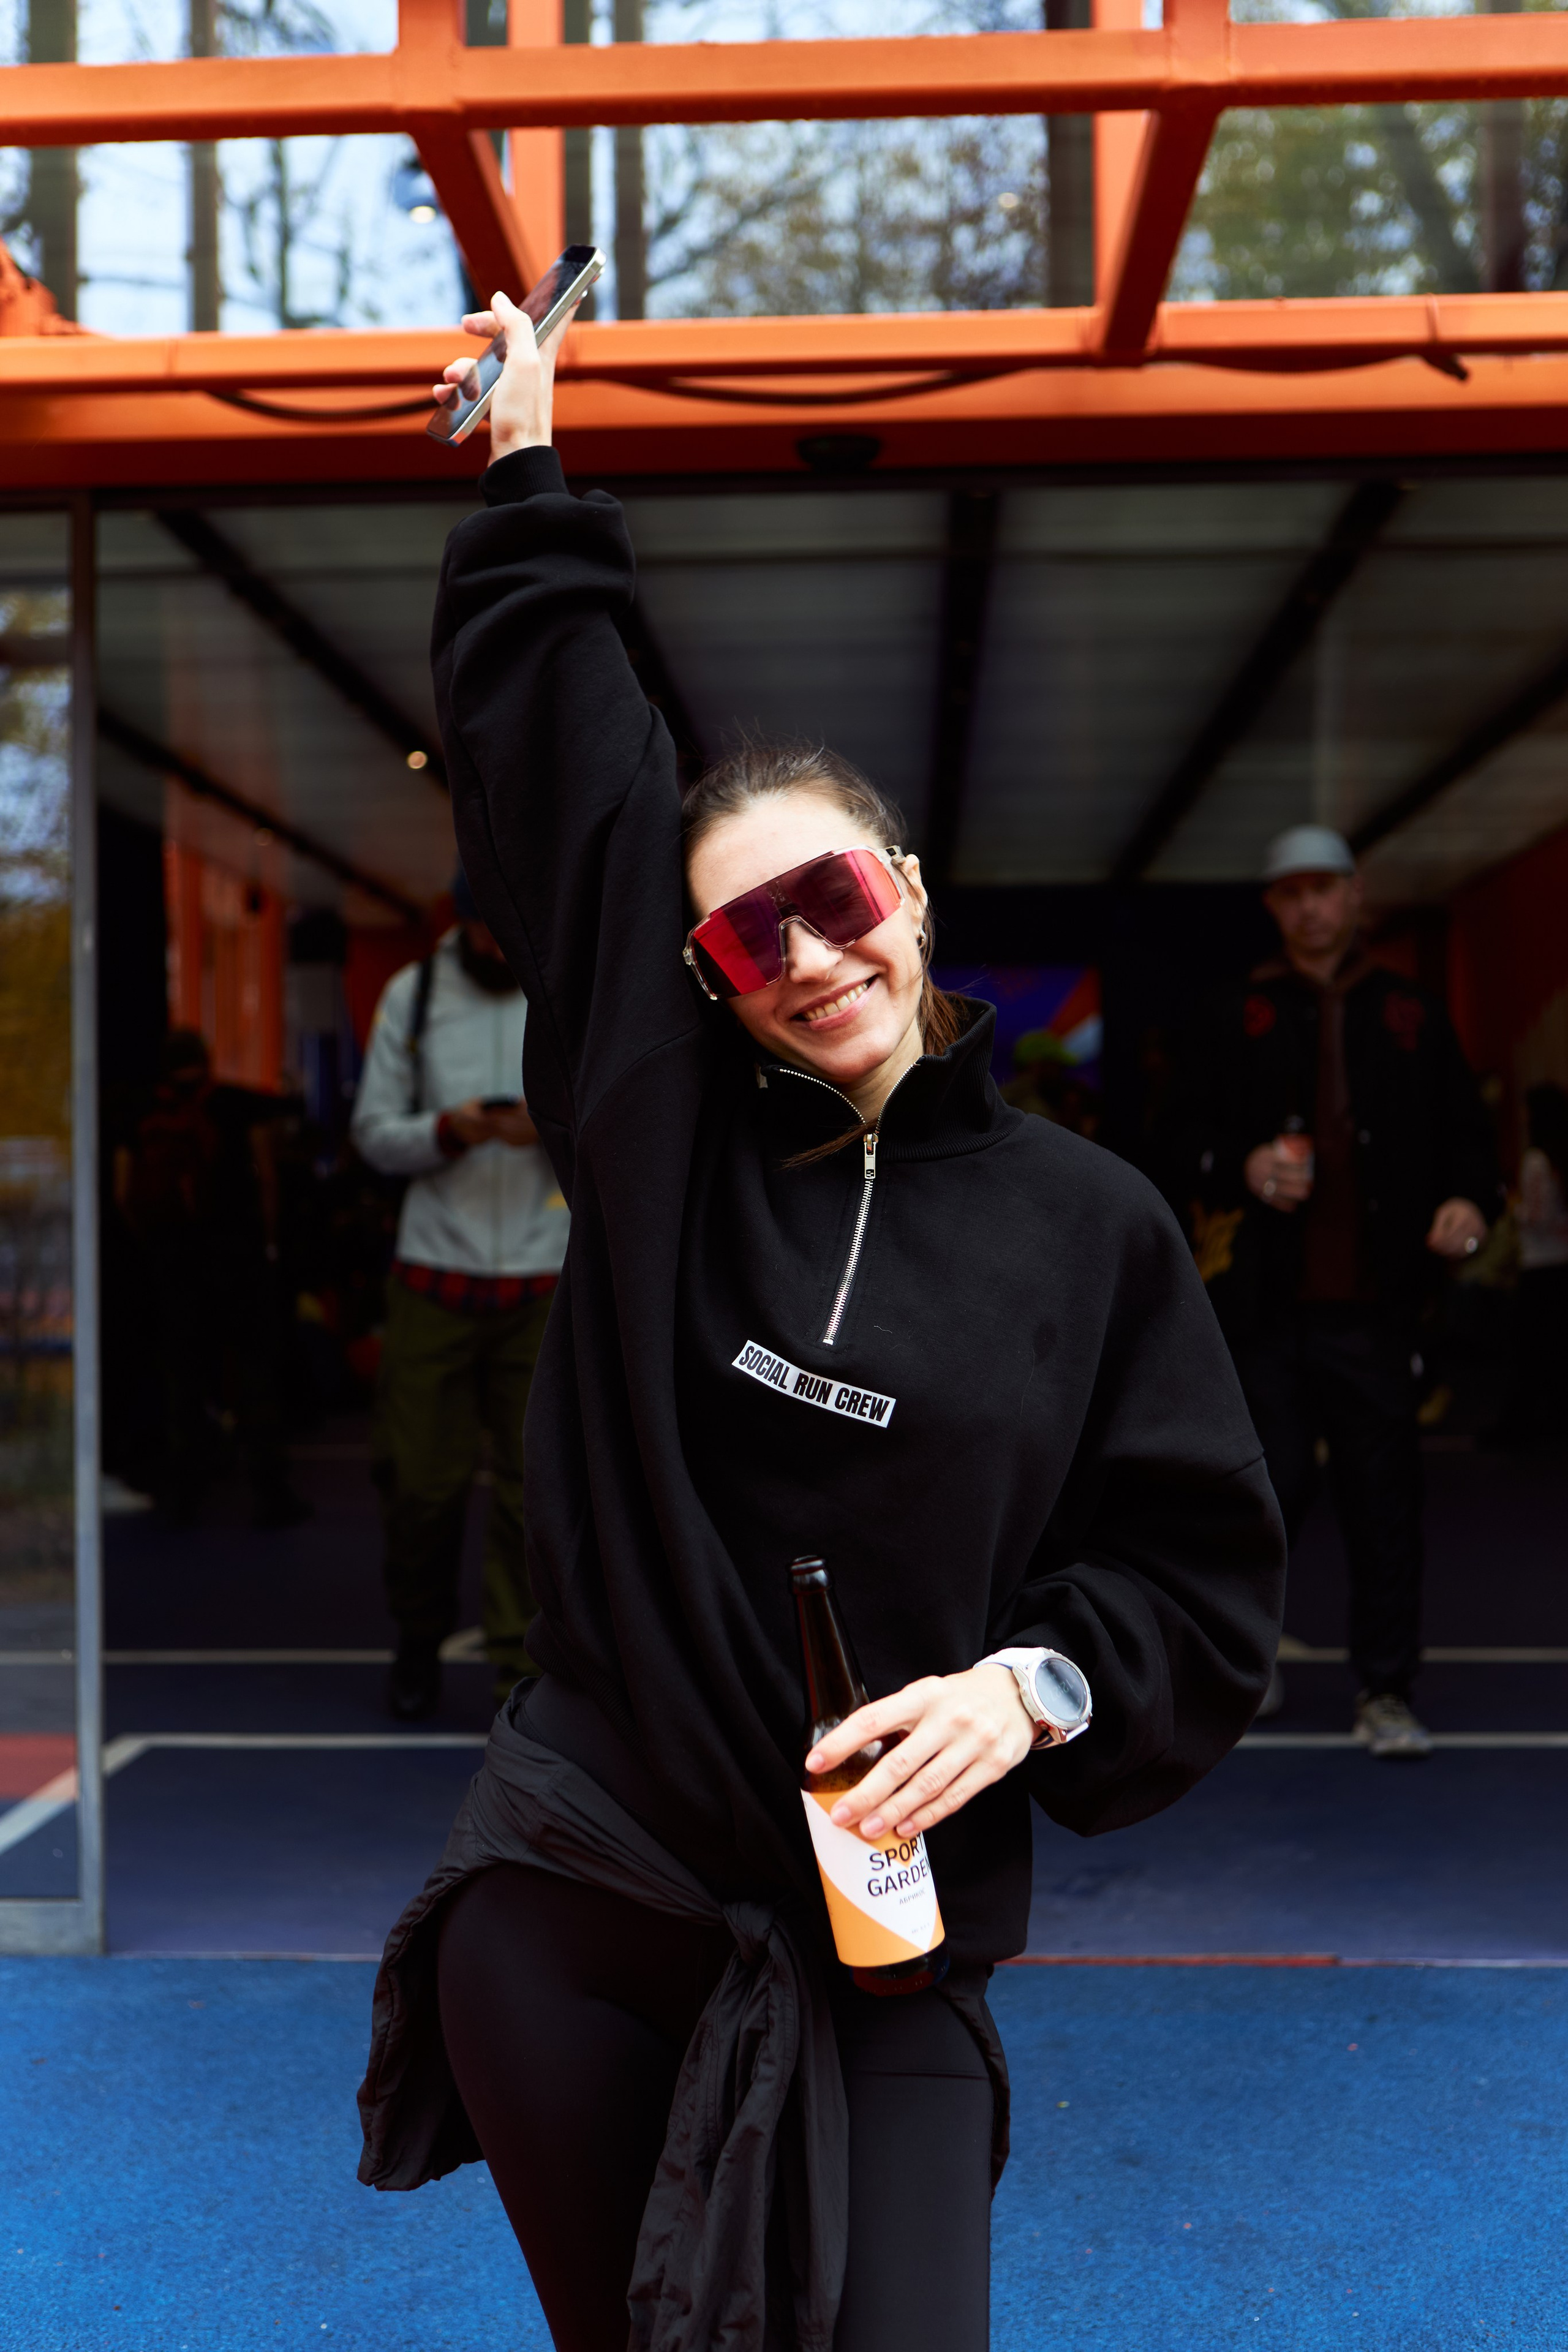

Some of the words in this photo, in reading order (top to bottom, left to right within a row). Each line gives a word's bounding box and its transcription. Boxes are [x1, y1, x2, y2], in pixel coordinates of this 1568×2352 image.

[739, 1346, 790, 1390] SOCIAL
[793, 1373, 833, 1404] RUN
[834, 1387, 890, 1422] CREW
[869, 1831, 924, 1871] SPORT
